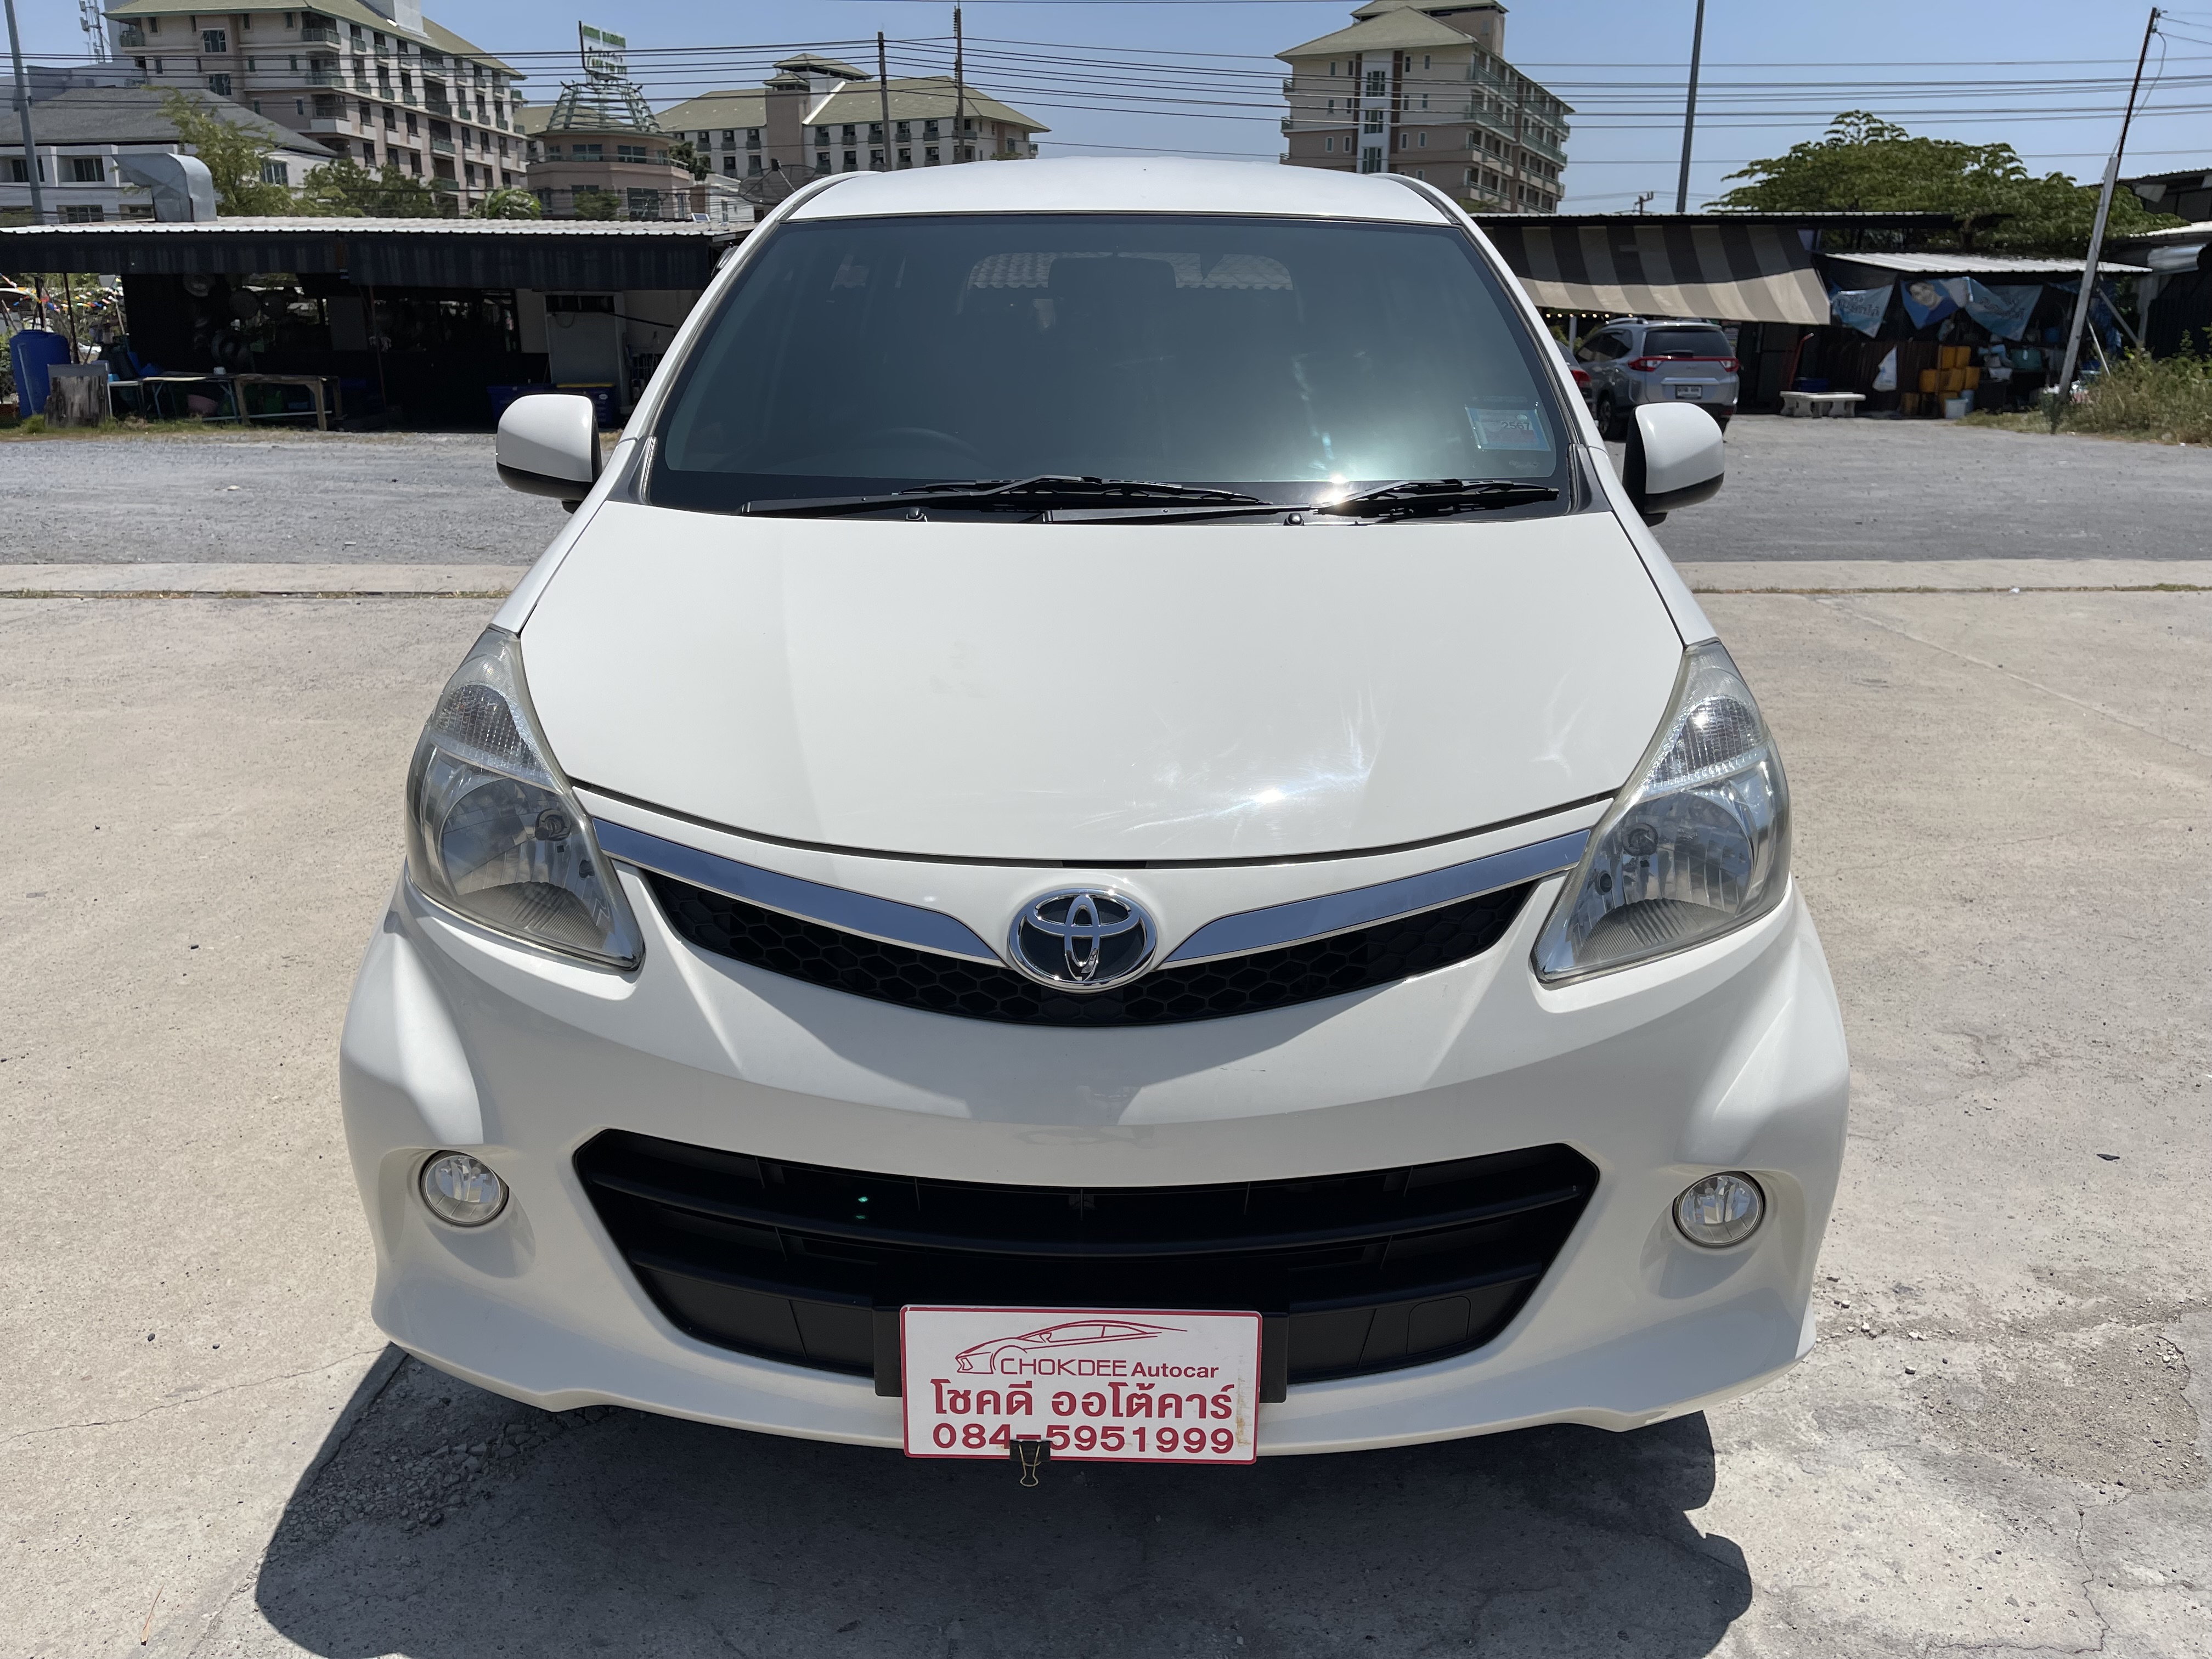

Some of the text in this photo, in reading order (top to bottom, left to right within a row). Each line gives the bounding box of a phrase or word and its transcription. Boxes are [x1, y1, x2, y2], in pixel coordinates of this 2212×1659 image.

[1501, 421, 1531, 430] 2567
[1001, 1358, 1219, 1379] CHOKDEE Autocar
[930, 1378, 1234, 1420] โชคดี ออโต้คาร์
[933, 1423, 1234, 1454] 084-5951999
